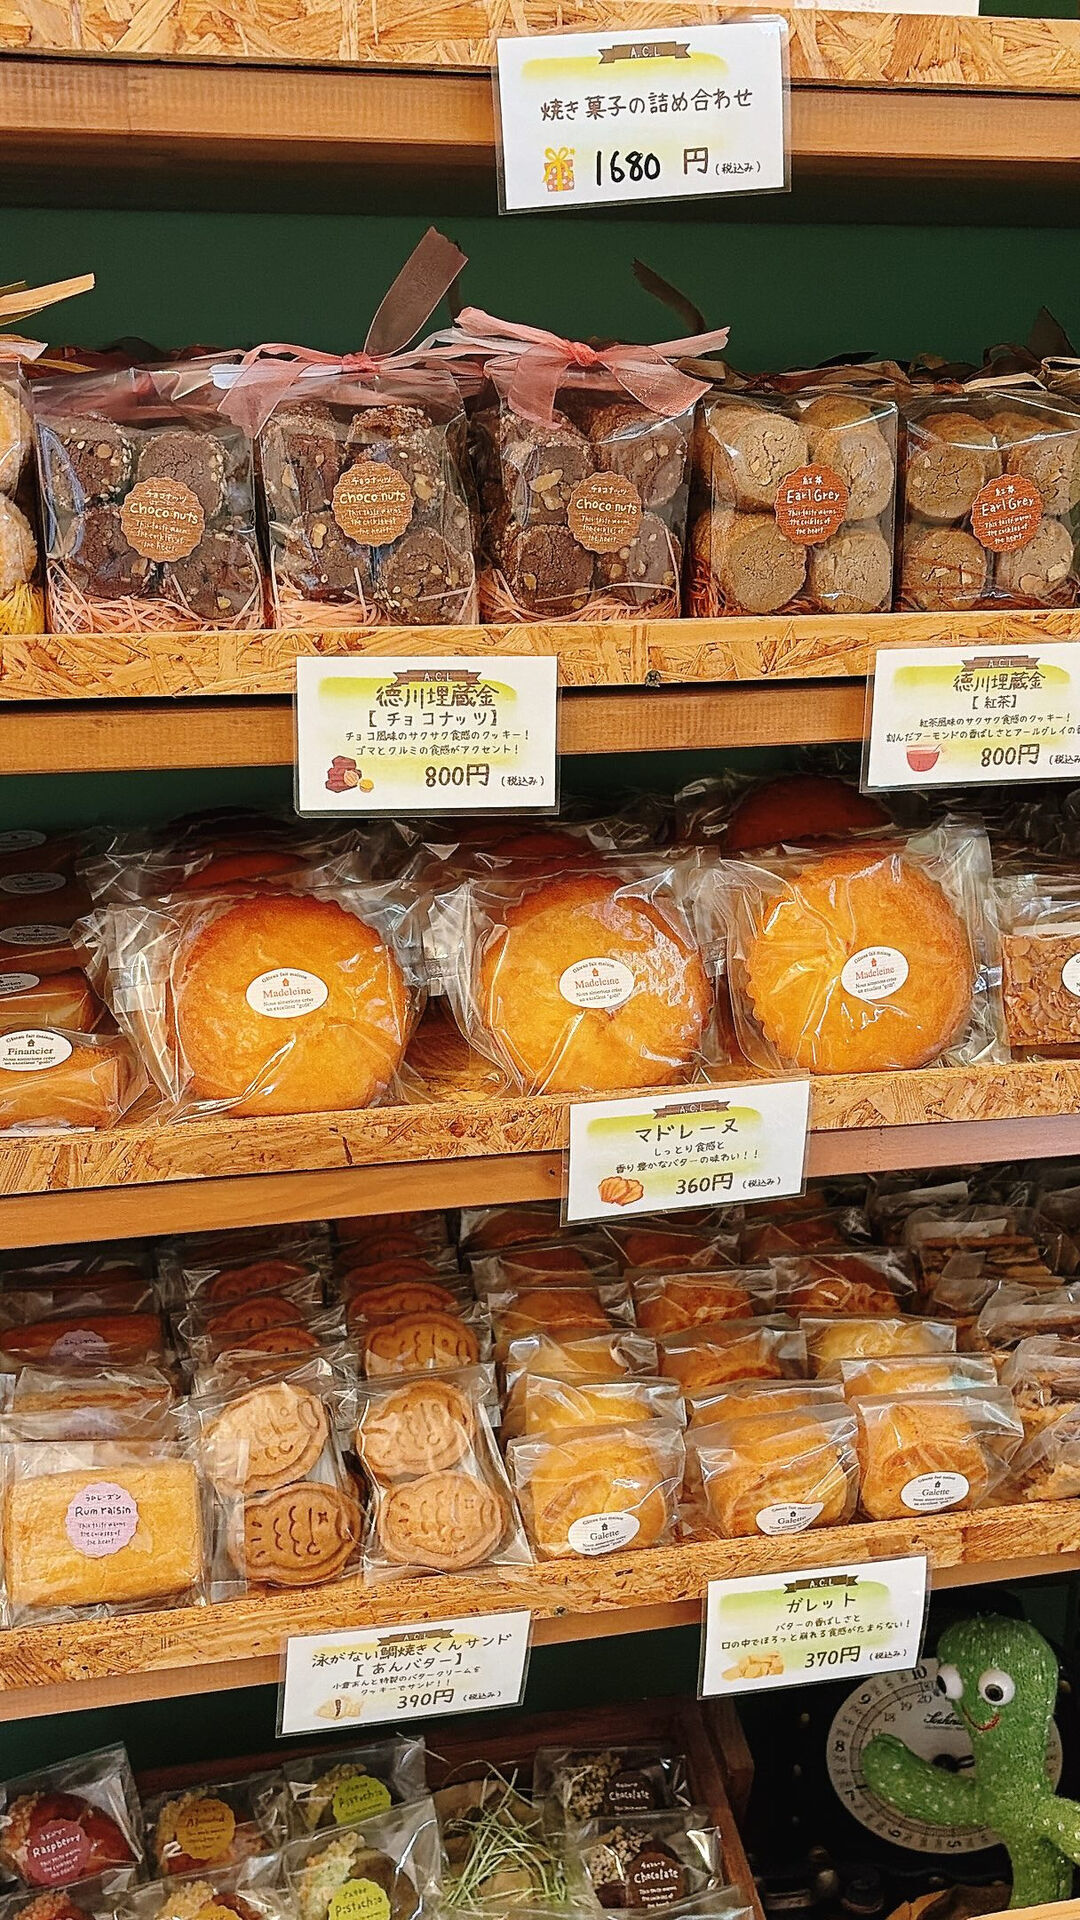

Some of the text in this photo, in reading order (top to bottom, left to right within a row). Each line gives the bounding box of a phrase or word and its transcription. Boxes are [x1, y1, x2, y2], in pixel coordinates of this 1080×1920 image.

[540, 87, 753, 122] 焼き菓子の詰め合わせ
[596, 146, 762, 186] 1680 円 （税込み）
[340, 490, 407, 504] Choco nuts
[786, 488, 840, 504] Earl Grey
[129, 501, 199, 525] Choco nuts
[576, 497, 638, 515] Choco nuts
[981, 497, 1035, 517] Earl Grey
[953, 671, 1046, 693] 徳川埋蔵金
[376, 684, 500, 710] 徳川埋蔵金
[971, 694, 1017, 710] 【紅茶】
[369, 709, 498, 728] 【チョコナッツ】
[355, 743, 519, 757] ゴマとクルミの食感がアクセント！
[980, 743, 1041, 769] 800円
[424, 763, 490, 788] 800円
[855, 966, 895, 981] Madeleine
[574, 977, 620, 990] Madeleine
[262, 987, 312, 999] Madeleine
[7, 1047, 54, 1056] Financier
[634, 1117, 739, 1143] マドレーヌ
[654, 1140, 725, 1157] しっとり食感と
[675, 1172, 733, 1196] 360円
[921, 1488, 951, 1497] Galette
[74, 1505, 132, 1518] Rum raisin
[589, 1529, 620, 1542] Galette
[809, 1578, 835, 1589] A.C.L
[786, 1592, 857, 1615] ガレット
[775, 1614, 861, 1632] バターの香ばしさと
[311, 1632, 513, 1668] 泳がない鯛焼きくんサンド
[804, 1645, 861, 1669] 370円
[356, 1652, 463, 1678] 【あんバター】
[912, 1665, 928, 1680] 10
[396, 1688, 455, 1710] 390円
[32, 1834, 80, 1858] Raspberry
[634, 1868, 679, 1884] Chocolate
